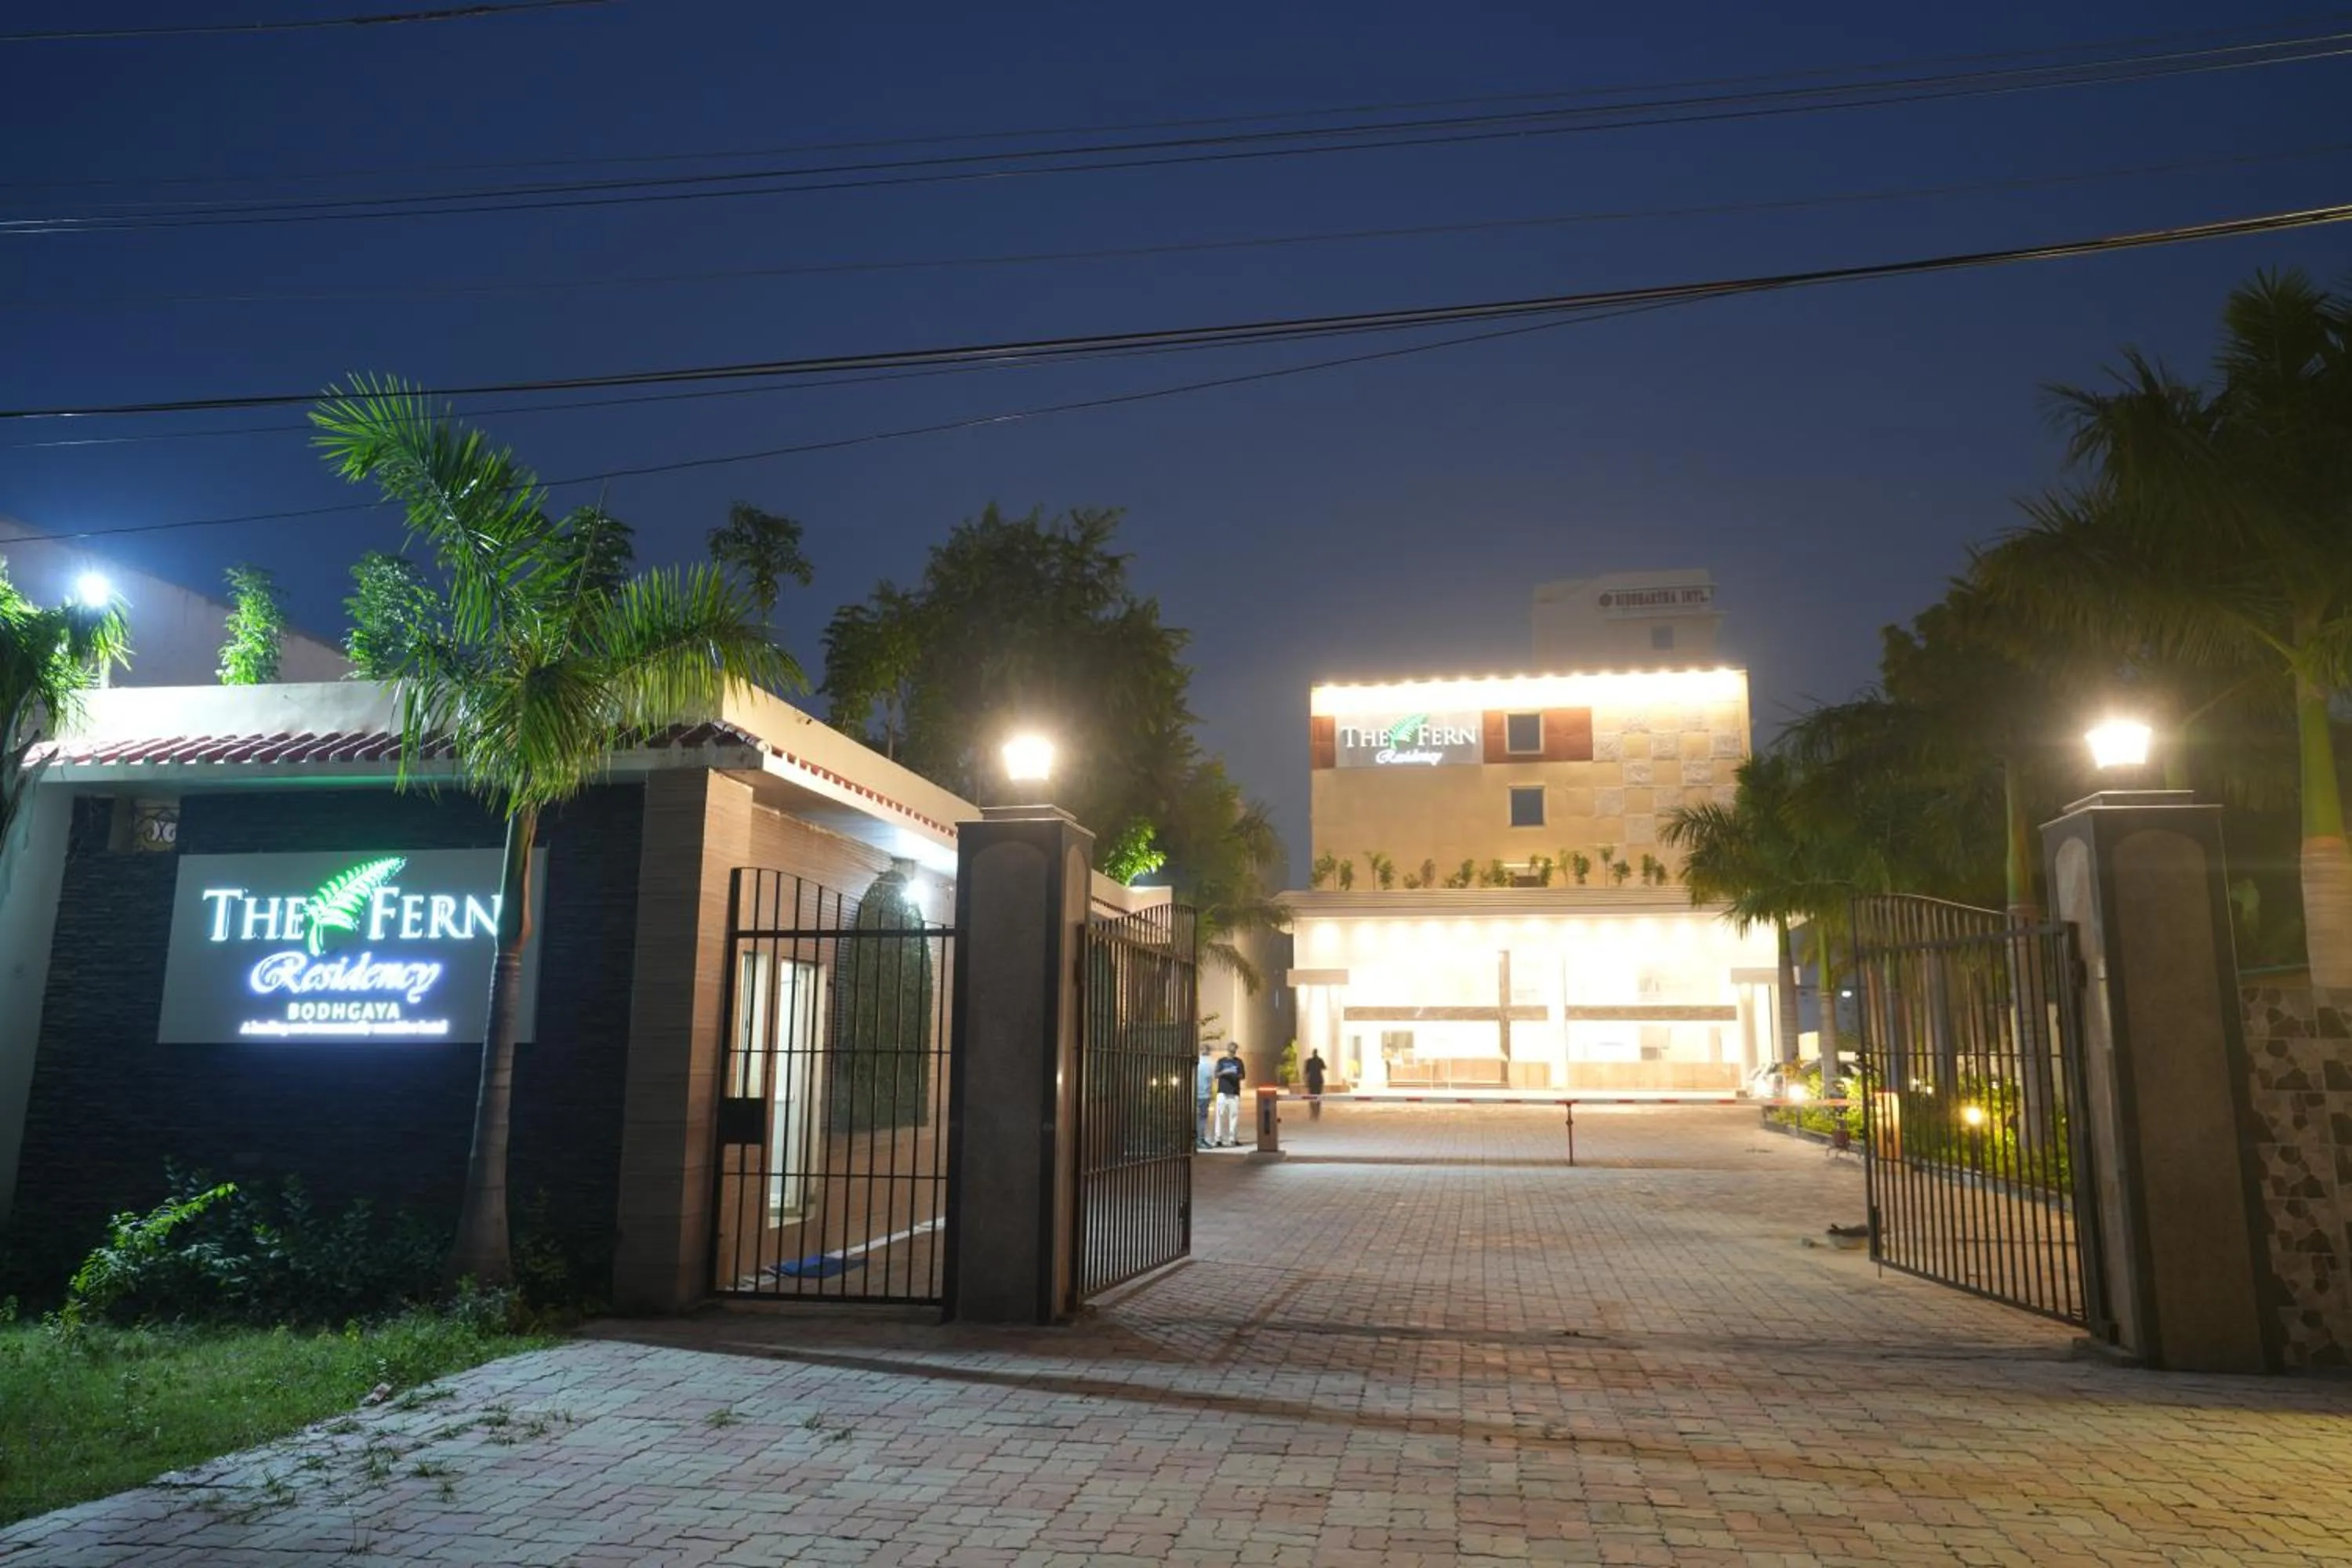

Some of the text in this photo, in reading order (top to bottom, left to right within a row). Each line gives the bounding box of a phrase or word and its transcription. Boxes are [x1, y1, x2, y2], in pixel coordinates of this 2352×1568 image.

[1341, 724, 1477, 748] THE FERN
[202, 886, 502, 942] THE FERN
[249, 950, 442, 1004] Residency
[287, 1001, 401, 1021] BODHGAYA
